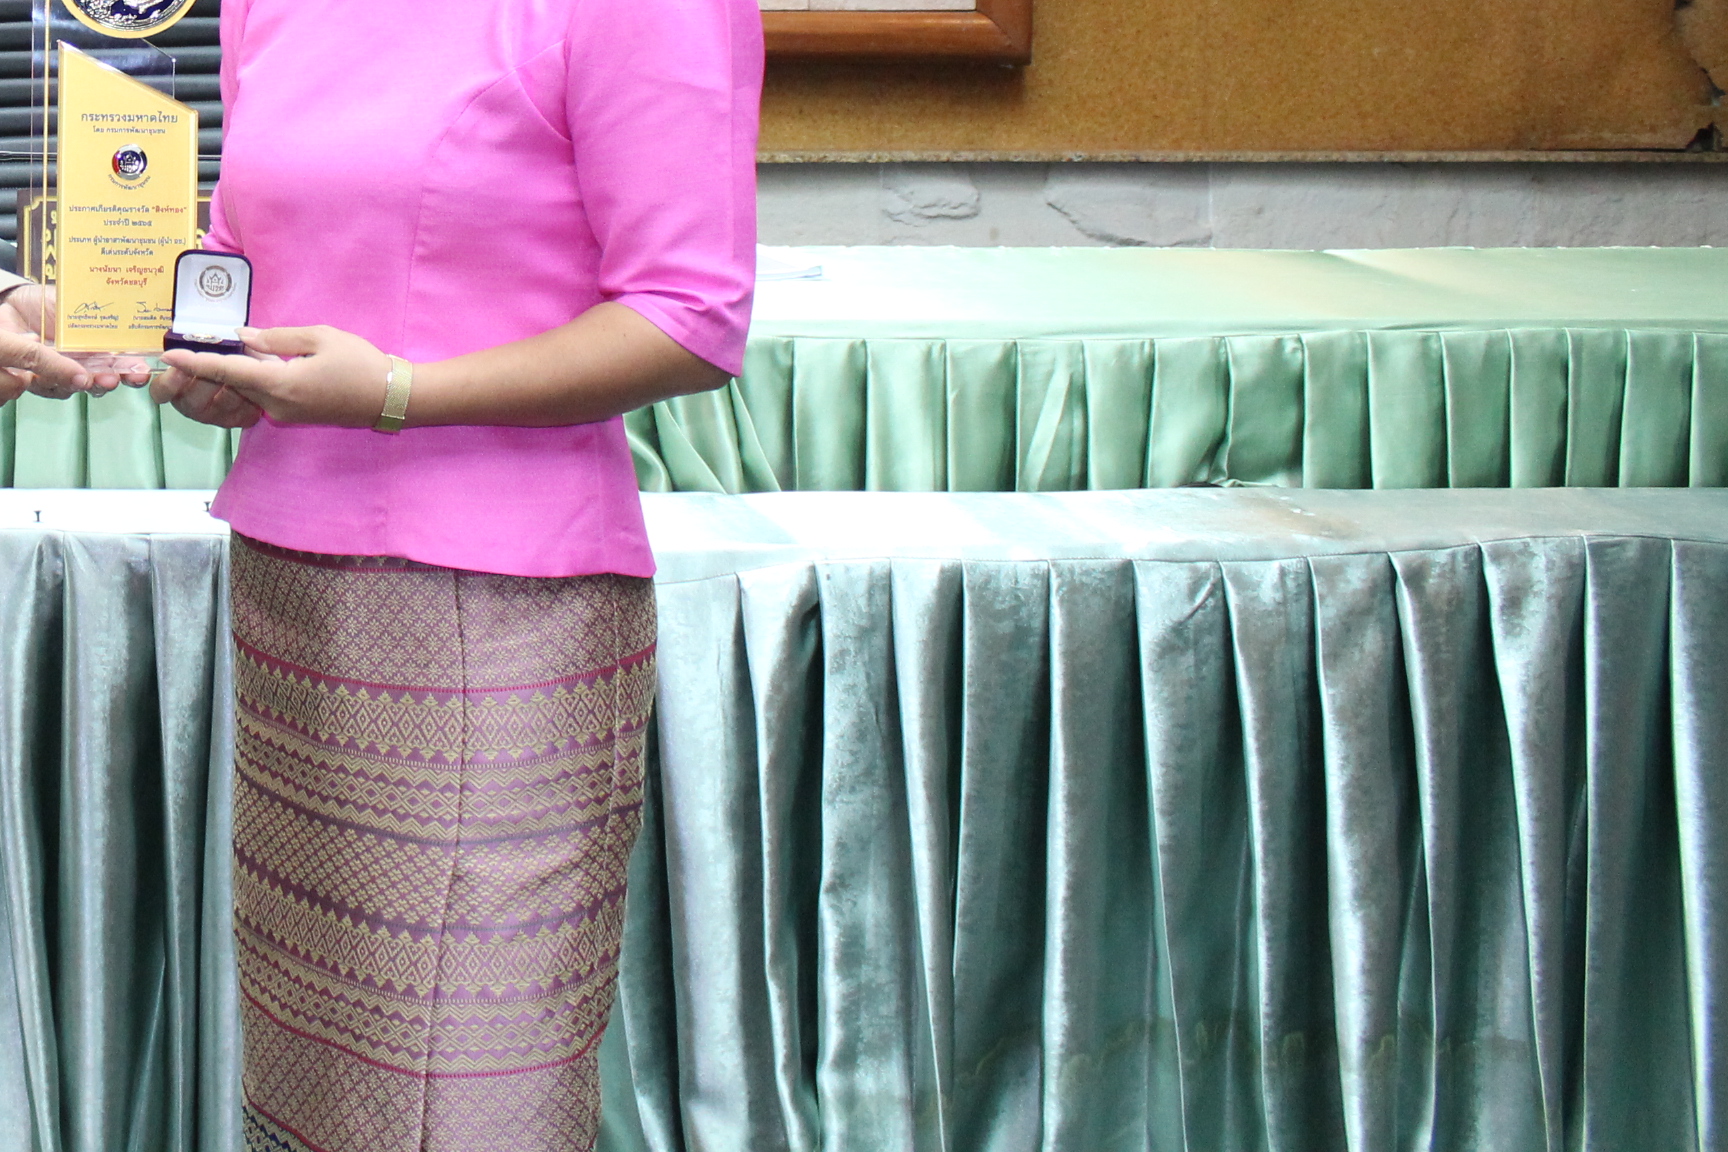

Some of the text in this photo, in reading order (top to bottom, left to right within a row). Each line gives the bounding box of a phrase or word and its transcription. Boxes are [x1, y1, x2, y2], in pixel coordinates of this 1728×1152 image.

[80, 110, 178, 123] กระทรวงมหาดไทย
[93, 125, 166, 136] โดย กรมการพัฒนาชุมชน
[104, 217, 130, 227] ประจำปี
[106, 277, 148, 288] จังหวัดชลบุรี
